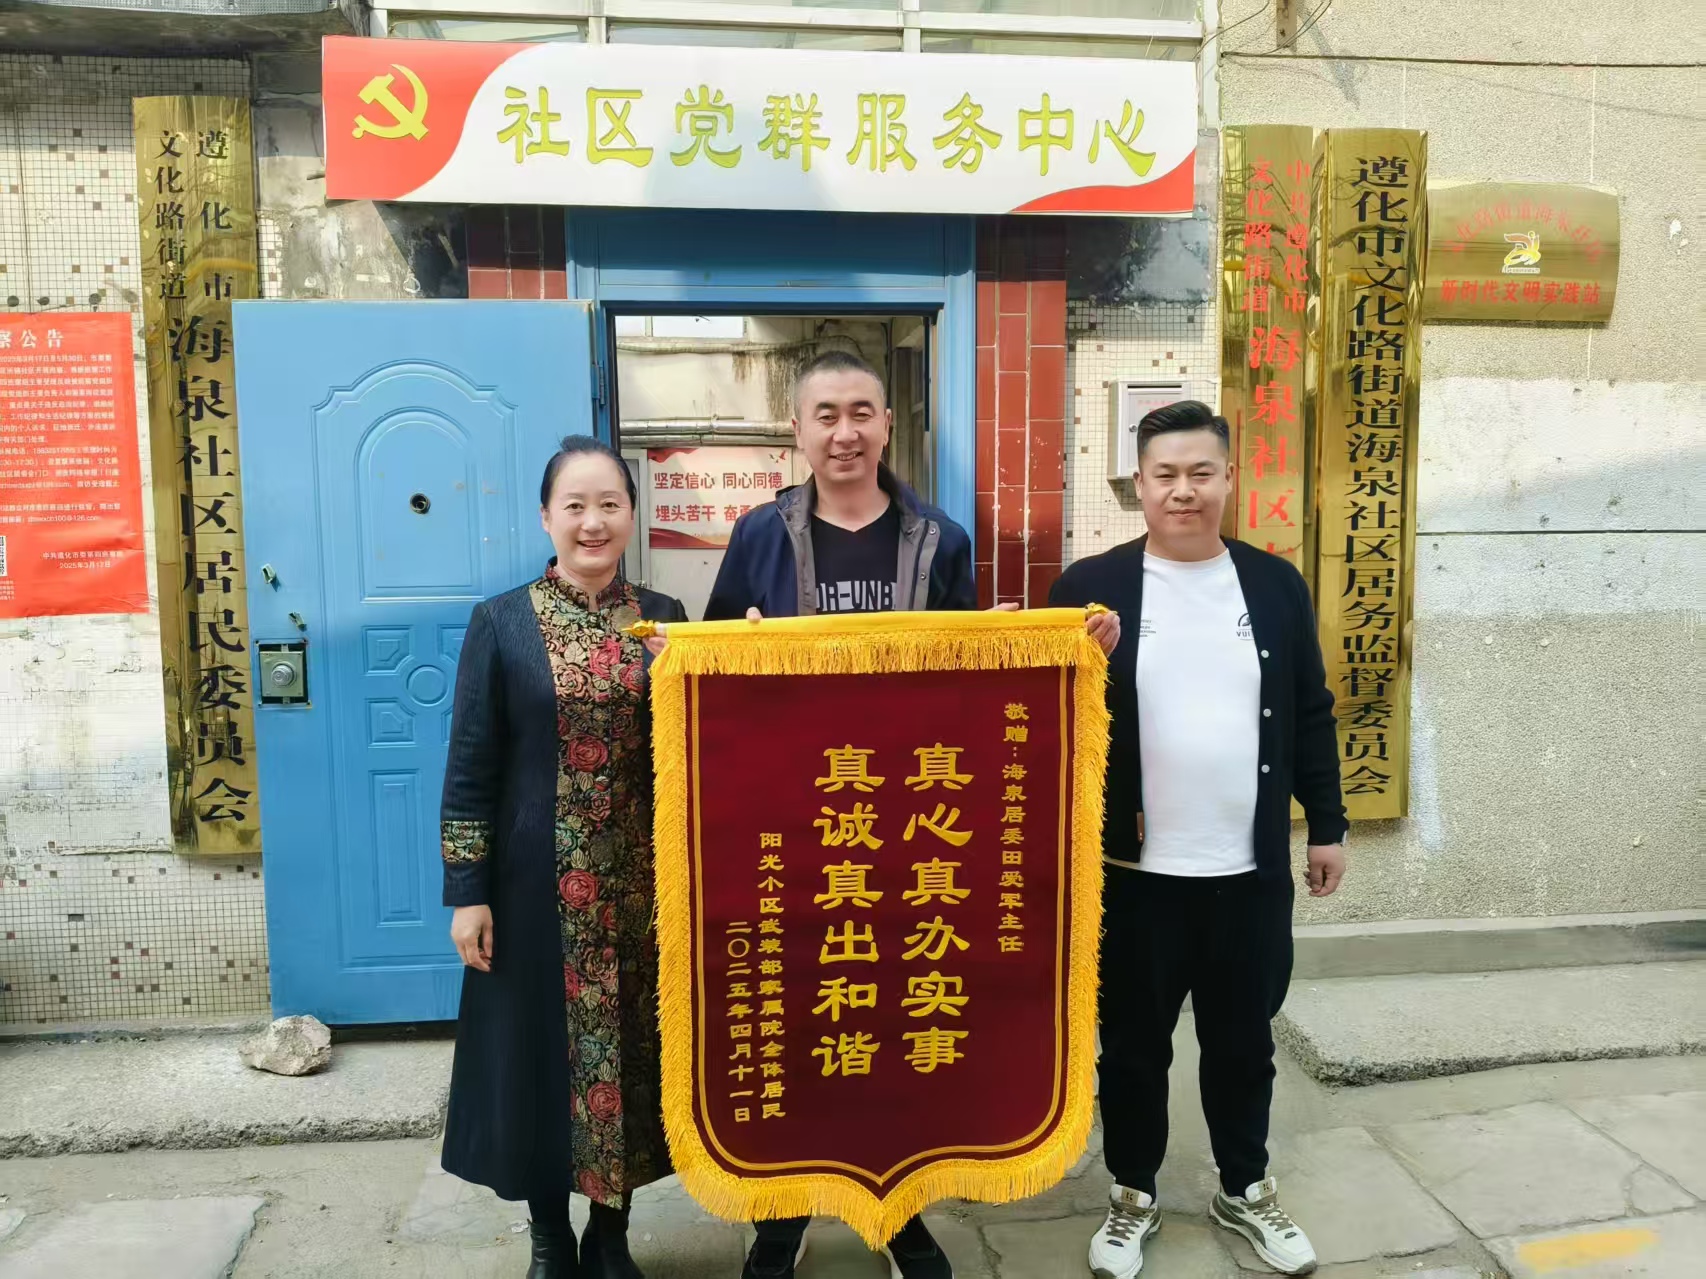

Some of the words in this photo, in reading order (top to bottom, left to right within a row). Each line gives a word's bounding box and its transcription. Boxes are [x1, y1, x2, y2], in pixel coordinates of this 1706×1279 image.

[154, 130, 187, 299] 文化路街道
[194, 130, 234, 300] 遵化市
[496, 84, 1157, 177] 社区党群服务中心
[1241, 155, 1274, 313] 文化路街道
[1283, 159, 1311, 313] 中共遵化市
[1441, 279, 1601, 304] 新时代文明实践站
[654, 472, 715, 489] 坚定信心
[722, 472, 783, 489] 同心同德
[655, 504, 716, 522] 埋头苦干
[1248, 325, 1304, 555] 海泉社区
[1338, 156, 1409, 795] 遵化市文化路街道海泉社区居务监督委员会
[168, 315, 252, 823] 海泉社区居民委员会
[757, 832, 786, 1119] 阳光小区武装部家属院全体居民
[812, 743, 886, 1077] 真诚真出和谐
[901, 742, 975, 1074] 真心真办实事
